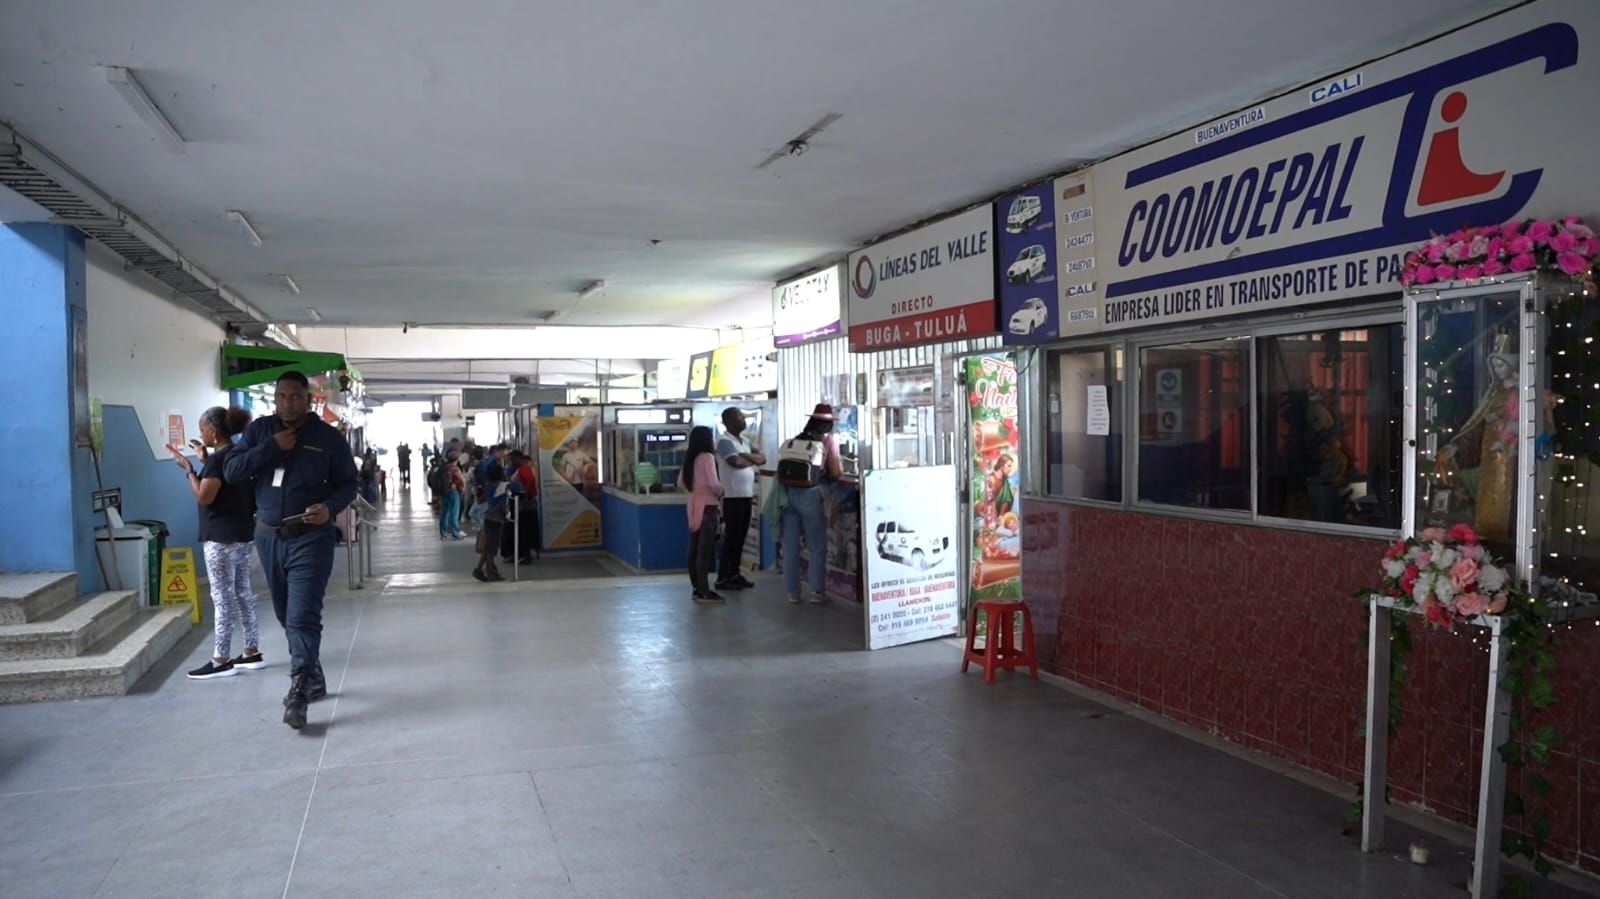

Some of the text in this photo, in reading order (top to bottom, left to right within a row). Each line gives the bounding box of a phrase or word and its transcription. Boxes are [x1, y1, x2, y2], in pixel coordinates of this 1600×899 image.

[1311, 73, 1361, 103] CALI
[1197, 108, 1264, 143] BUENAVENTURA
[1117, 135, 1366, 268] COOMOEPAL
[880, 230, 988, 281] LÍNEAS DEL VALLE
[891, 295, 934, 315] DIRECTO
[1105, 250, 1412, 324] EMPRESA LIDER EN TRANSPORTE DE PA
[865, 325, 901, 346] BUGA
[914, 308, 967, 339] TULUÁ
